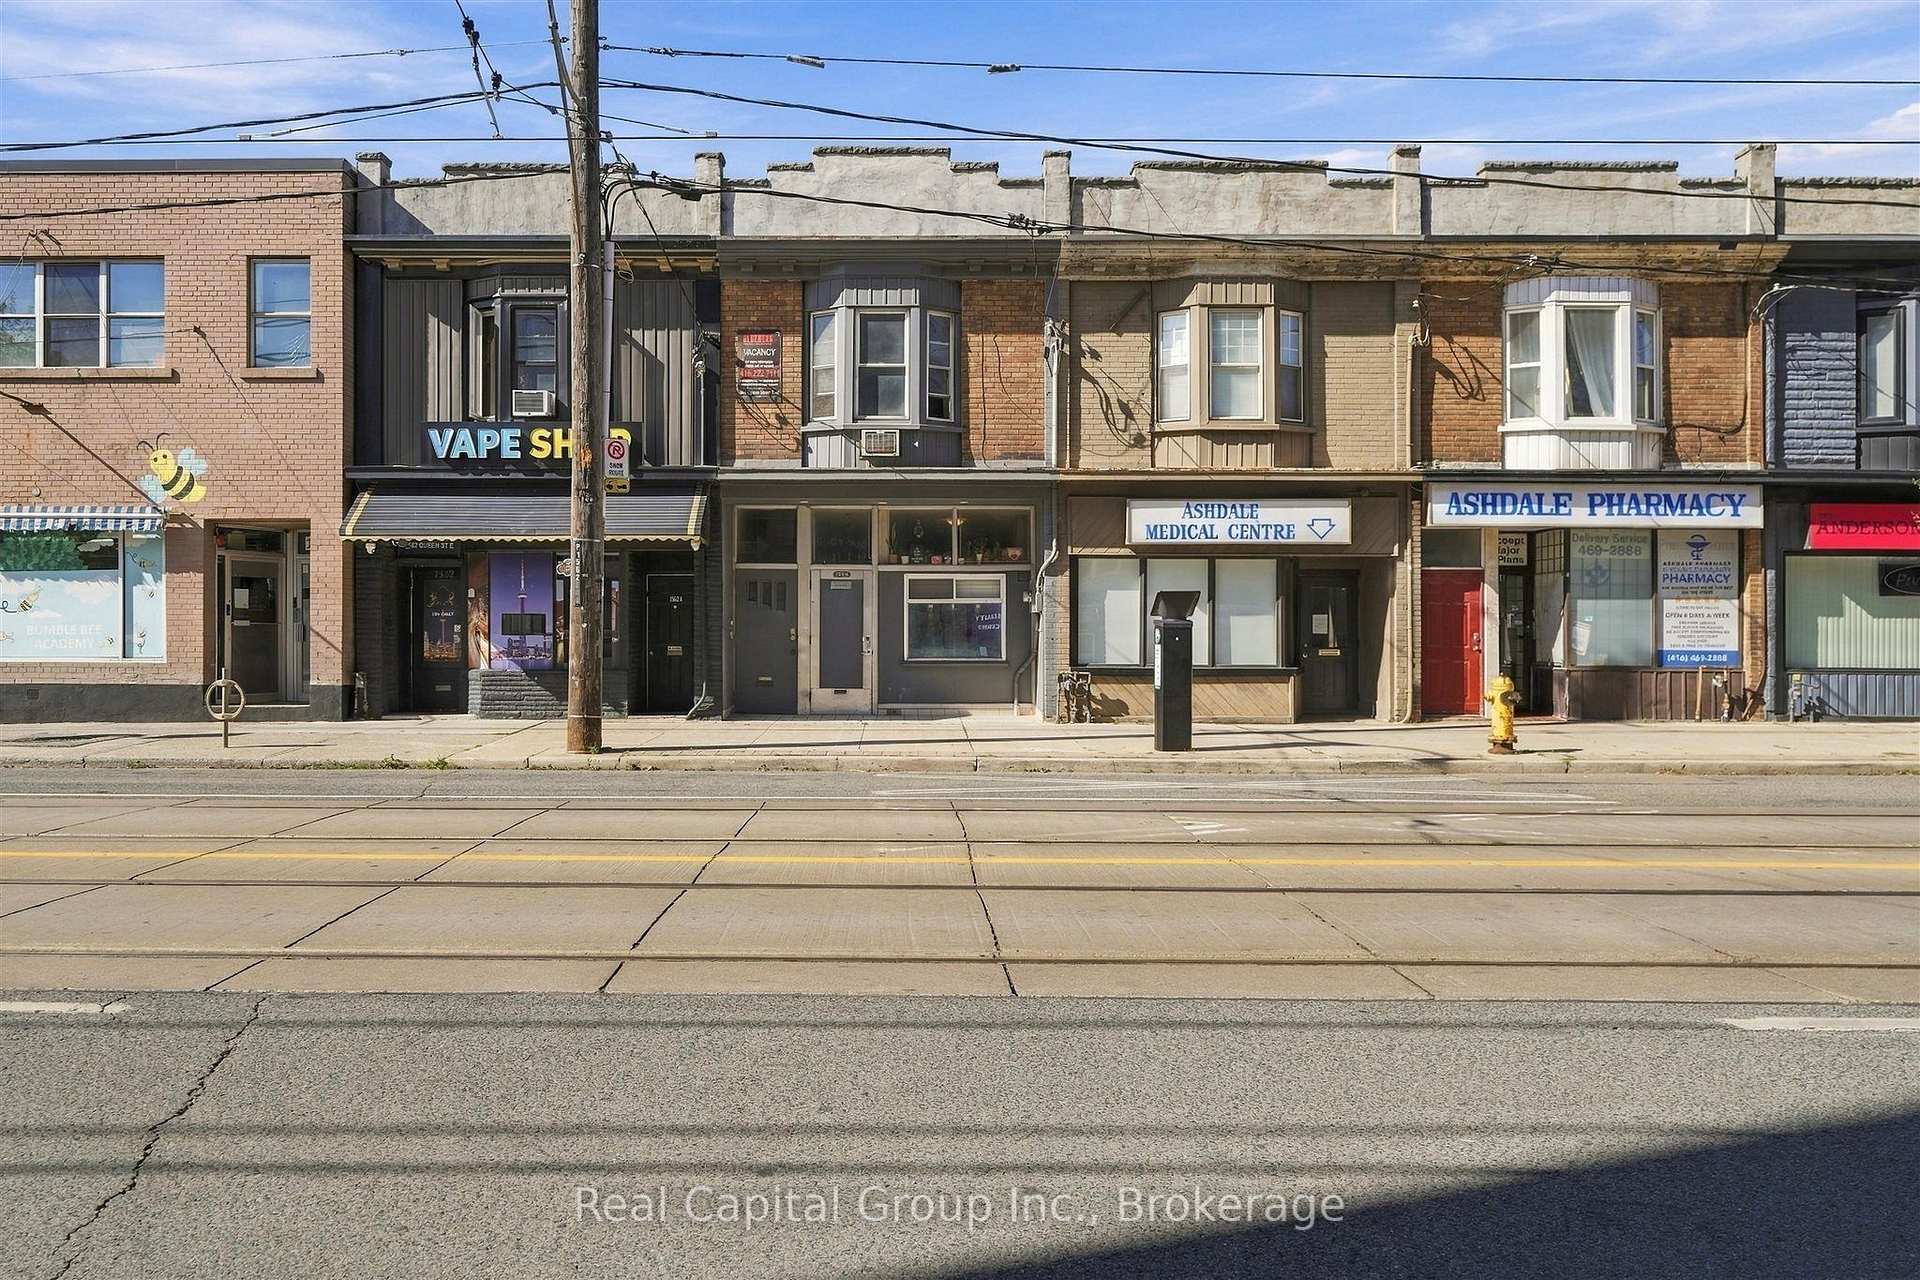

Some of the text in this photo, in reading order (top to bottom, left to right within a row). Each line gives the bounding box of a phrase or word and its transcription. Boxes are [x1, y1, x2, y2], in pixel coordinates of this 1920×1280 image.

[743, 348, 776, 356] VACANCY
[428, 428, 631, 459] VAPE SH
[1182, 502, 1259, 519] ASHDALE
[1445, 492, 1746, 517] ASHDALE PHARMACY
[1145, 524, 1296, 540] MEDICAL CENTRE
[1572, 533, 1648, 545] Delivery Service
[1498, 546, 1520, 555] ajor
[1578, 544, 1642, 556] 469-2888
[1662, 573, 1731, 584] PHARMACY
[26, 624, 77, 636] BUMBLE
[33, 638, 95, 649] ACADEMY
[1667, 654, 1728, 662] (416) 469-2888
